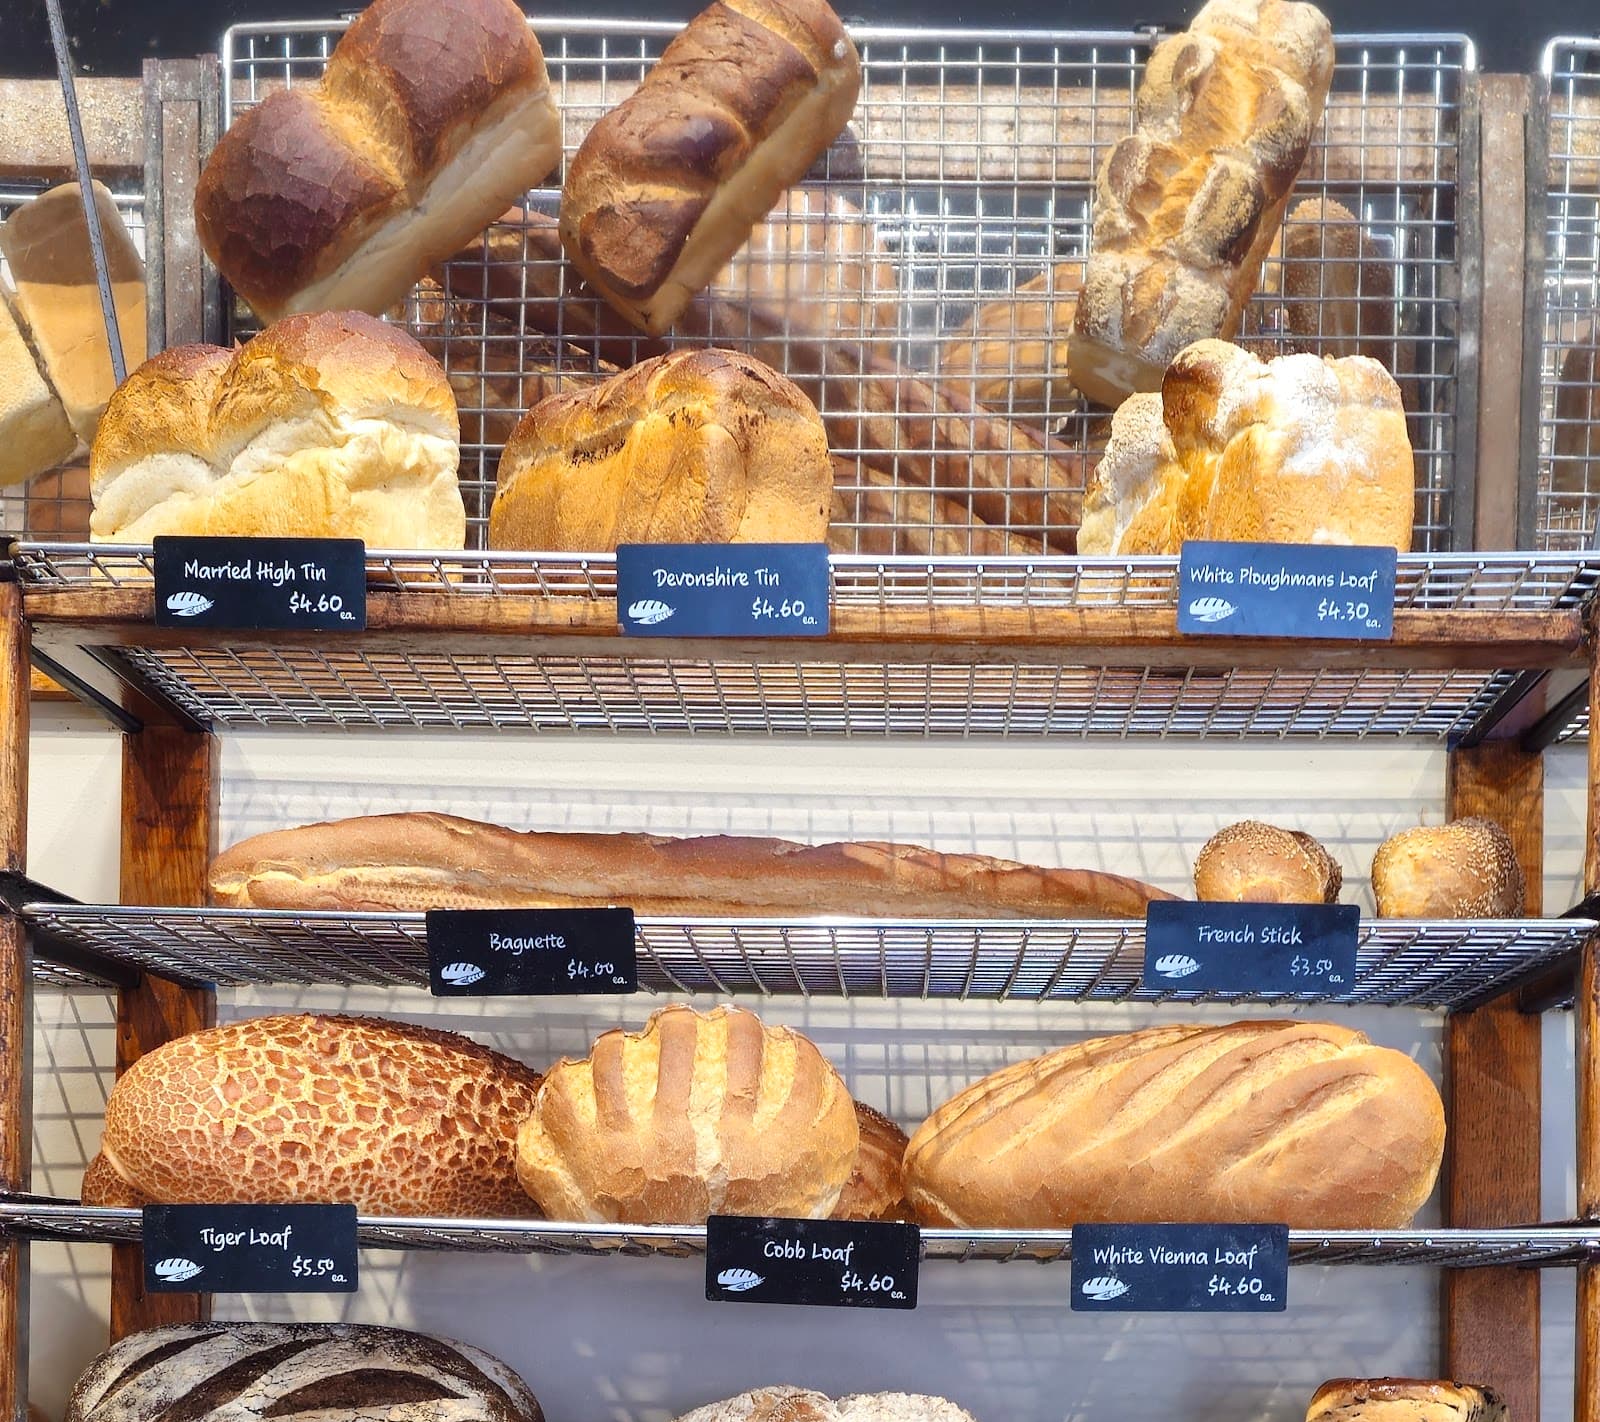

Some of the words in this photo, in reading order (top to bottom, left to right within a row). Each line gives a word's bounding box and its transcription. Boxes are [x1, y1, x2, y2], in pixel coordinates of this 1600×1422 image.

[184, 559, 252, 580] Married
[256, 560, 295, 587] High
[301, 563, 326, 581] Tin
[653, 566, 749, 587] Devonshire
[754, 568, 780, 586] Tin
[1190, 565, 1234, 584] White
[1240, 567, 1334, 591] Ploughmans
[1340, 570, 1378, 592] Loaf
[289, 591, 343, 613] $4.60
[340, 611, 356, 620] ea.
[752, 597, 805, 620] $4.60
[803, 615, 818, 624] ea.
[1317, 598, 1369, 621] $4.30
[1366, 618, 1381, 628] ea.
[490, 932, 567, 956] Baguette
[1198, 925, 1255, 943] French
[1260, 926, 1303, 945] Stick
[567, 958, 614, 979] $4.00
[612, 976, 628, 984] ea.
[1290, 955, 1332, 976] $3.50
[1329, 974, 1345, 983] ea.
[200, 1227, 246, 1251] Tiger
[250, 1225, 293, 1251] Loaf
[764, 1239, 806, 1259] Cobb
[812, 1241, 855, 1265] Loaf
[1093, 1245, 1144, 1264] White
[1149, 1245, 1208, 1265] Vienna
[1215, 1244, 1258, 1270] Loaf
[291, 1255, 334, 1277] $5.50
[332, 1273, 348, 1282] ea.
[841, 1270, 895, 1292] $4.60
[891, 1290, 906, 1299] ea.
[1208, 1274, 1263, 1296] $4.60
[1259, 1292, 1275, 1302] ea.
